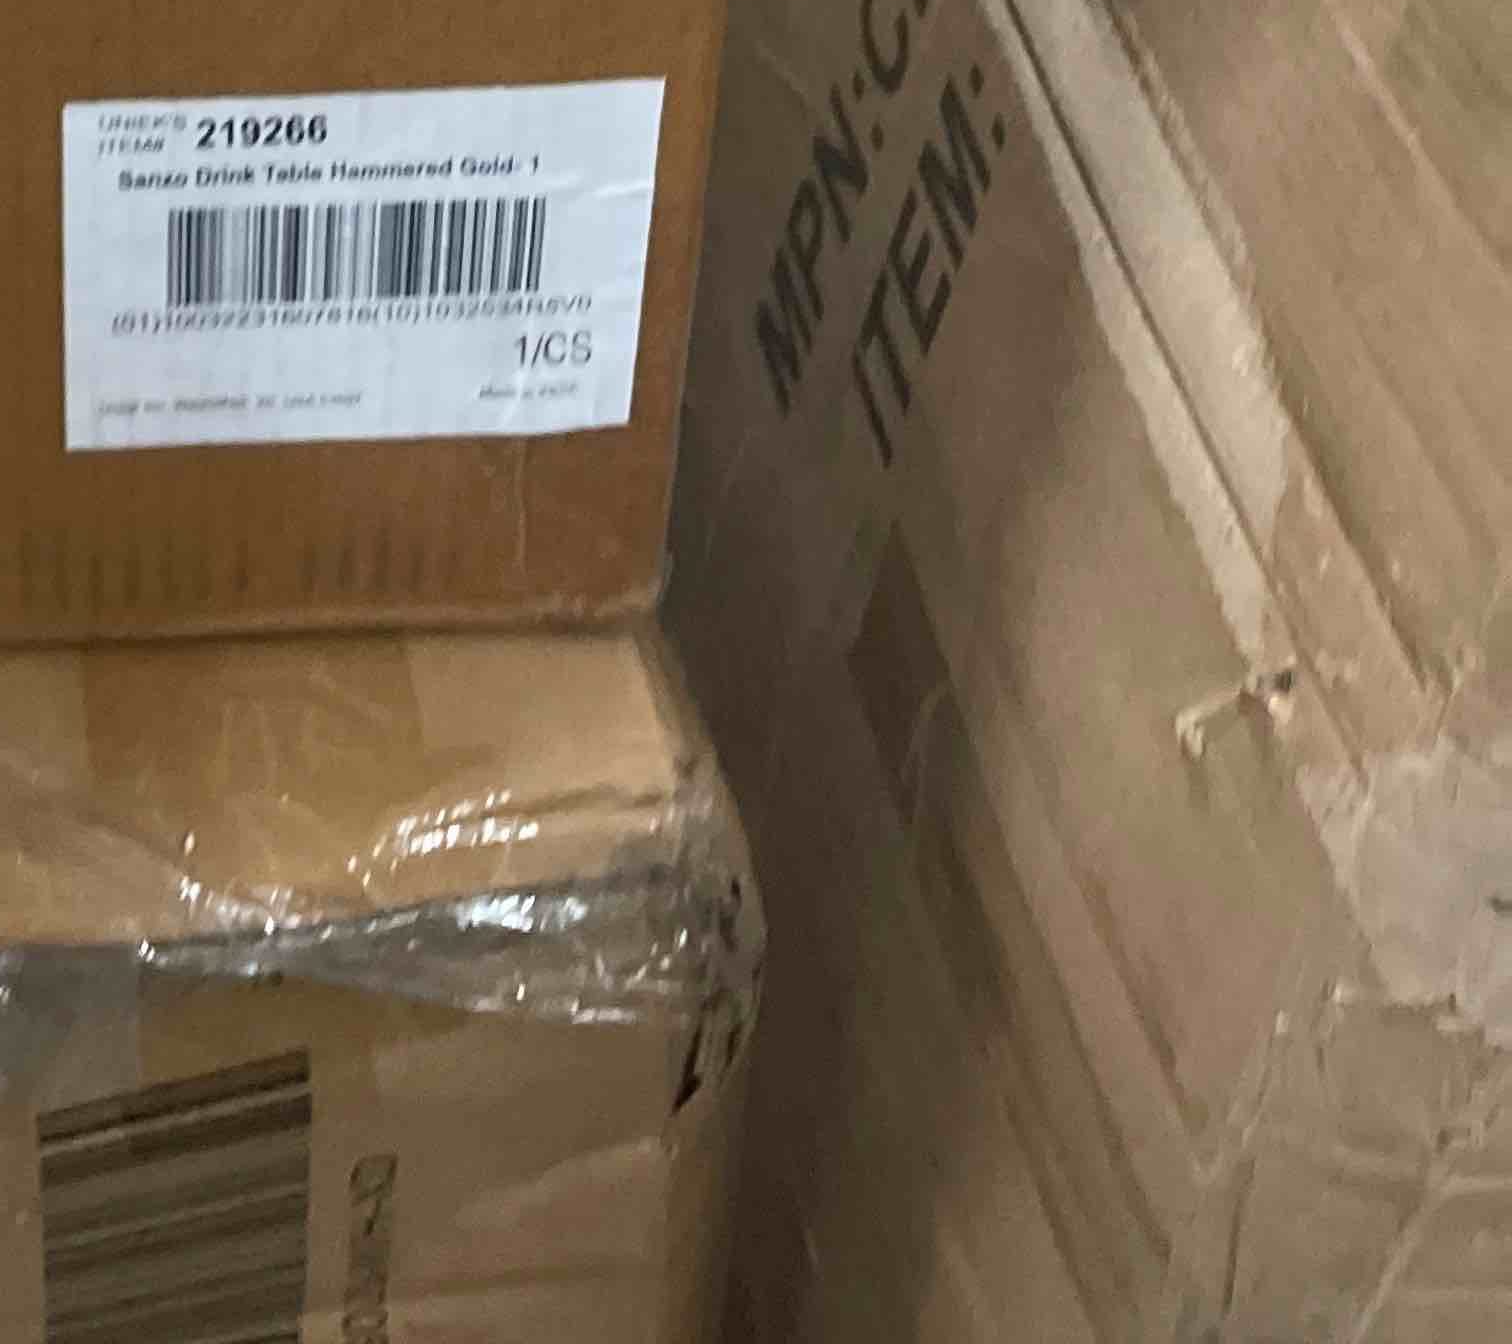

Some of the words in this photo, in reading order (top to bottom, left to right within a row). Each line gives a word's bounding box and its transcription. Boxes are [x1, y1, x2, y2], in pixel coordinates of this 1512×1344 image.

[194, 113, 329, 151] 219266
[195, 163, 256, 188] Drink
[264, 160, 324, 186] Table
[329, 154, 453, 182] Hammered
[851, 63, 1006, 469] ITEM:
[513, 329, 593, 369] 1/CS
